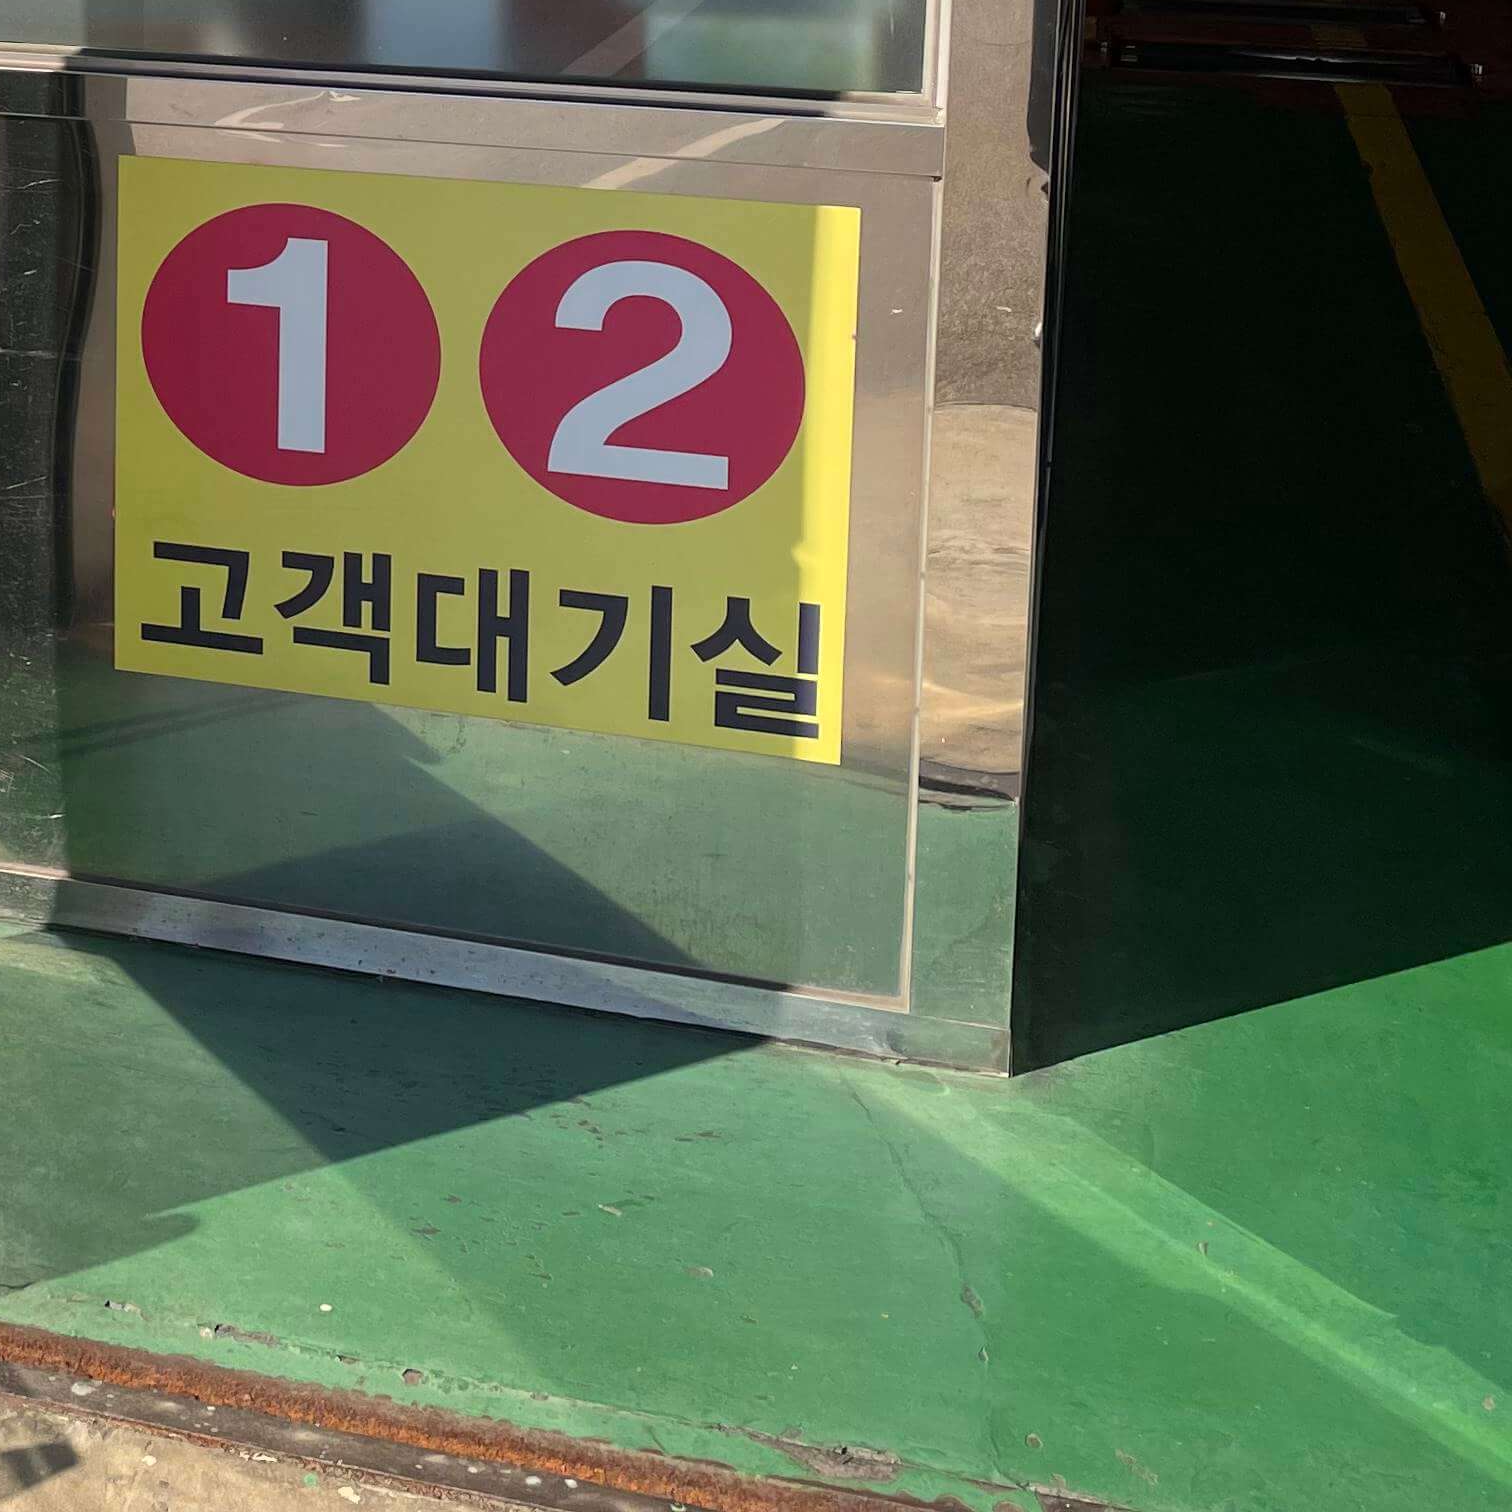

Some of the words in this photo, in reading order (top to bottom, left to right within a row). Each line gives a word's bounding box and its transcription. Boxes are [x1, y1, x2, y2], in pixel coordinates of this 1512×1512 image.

[227, 236, 329, 455] 1
[547, 259, 732, 491] 2
[140, 541, 821, 740] 고객대기실
